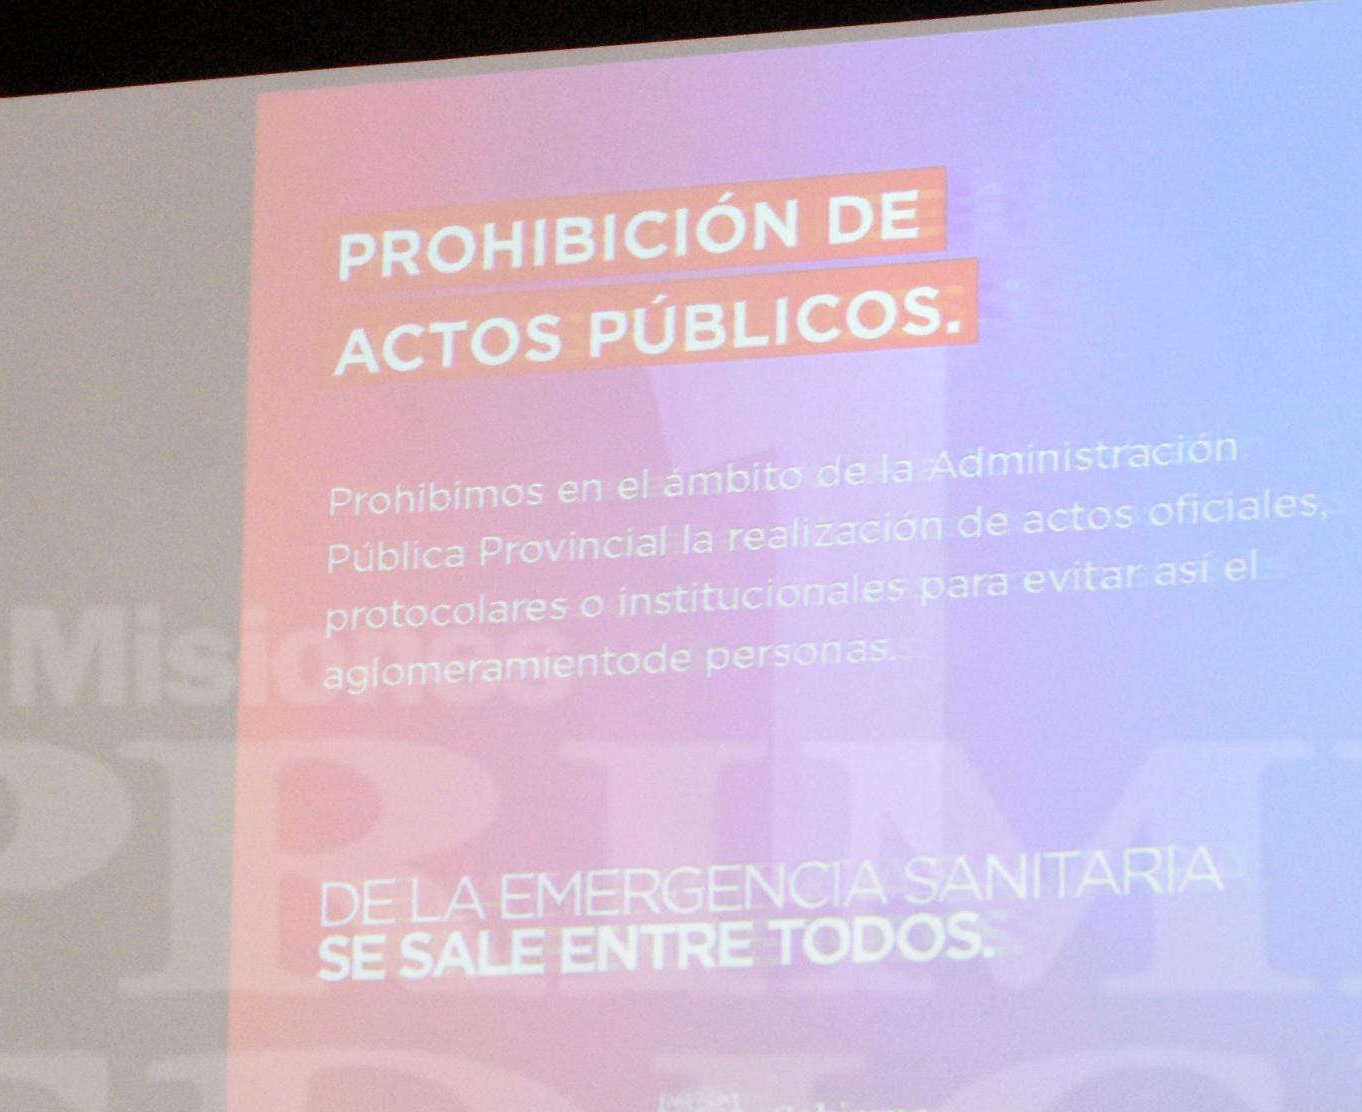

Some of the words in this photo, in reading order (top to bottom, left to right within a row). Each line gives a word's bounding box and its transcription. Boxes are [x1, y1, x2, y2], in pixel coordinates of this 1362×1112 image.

[339, 192, 799, 281] PROHIBICIÓN
[827, 190, 920, 245] DE
[333, 314, 563, 376] ACTOS
[589, 286, 962, 358] PÚBLICOS.
[328, 478, 543, 517] Prohibimos
[557, 475, 603, 503] en
[617, 467, 650, 500] el
[662, 459, 803, 498] ámbito
[816, 453, 867, 488] de
[880, 451, 914, 484] la
[931, 430, 1239, 480] Administración
[326, 540, 466, 574] Pública
[479, 525, 668, 567] Provincial
[682, 523, 714, 556] la
[728, 510, 943, 551] realización
[956, 504, 1009, 540] de
[1022, 497, 1134, 536] actos
[324, 592, 568, 638] protocolares
[580, 593, 605, 619] o
[617, 573, 907, 617] institucionales
[920, 570, 1009, 607] para
[1022, 558, 1139, 593] evitar
[1153, 551, 1210, 588] así
[1224, 547, 1260, 582] el
[320, 877, 397, 928] DE
[410, 874, 487, 924] LA
[500, 858, 888, 920] EMERGENCIA
[903, 844, 1225, 906] SANITARIA
[316, 934, 387, 982] SE
[398, 926, 545, 979] SALE
[559, 918, 756, 973] ENTRE
[766, 910, 996, 966] TODOS.
